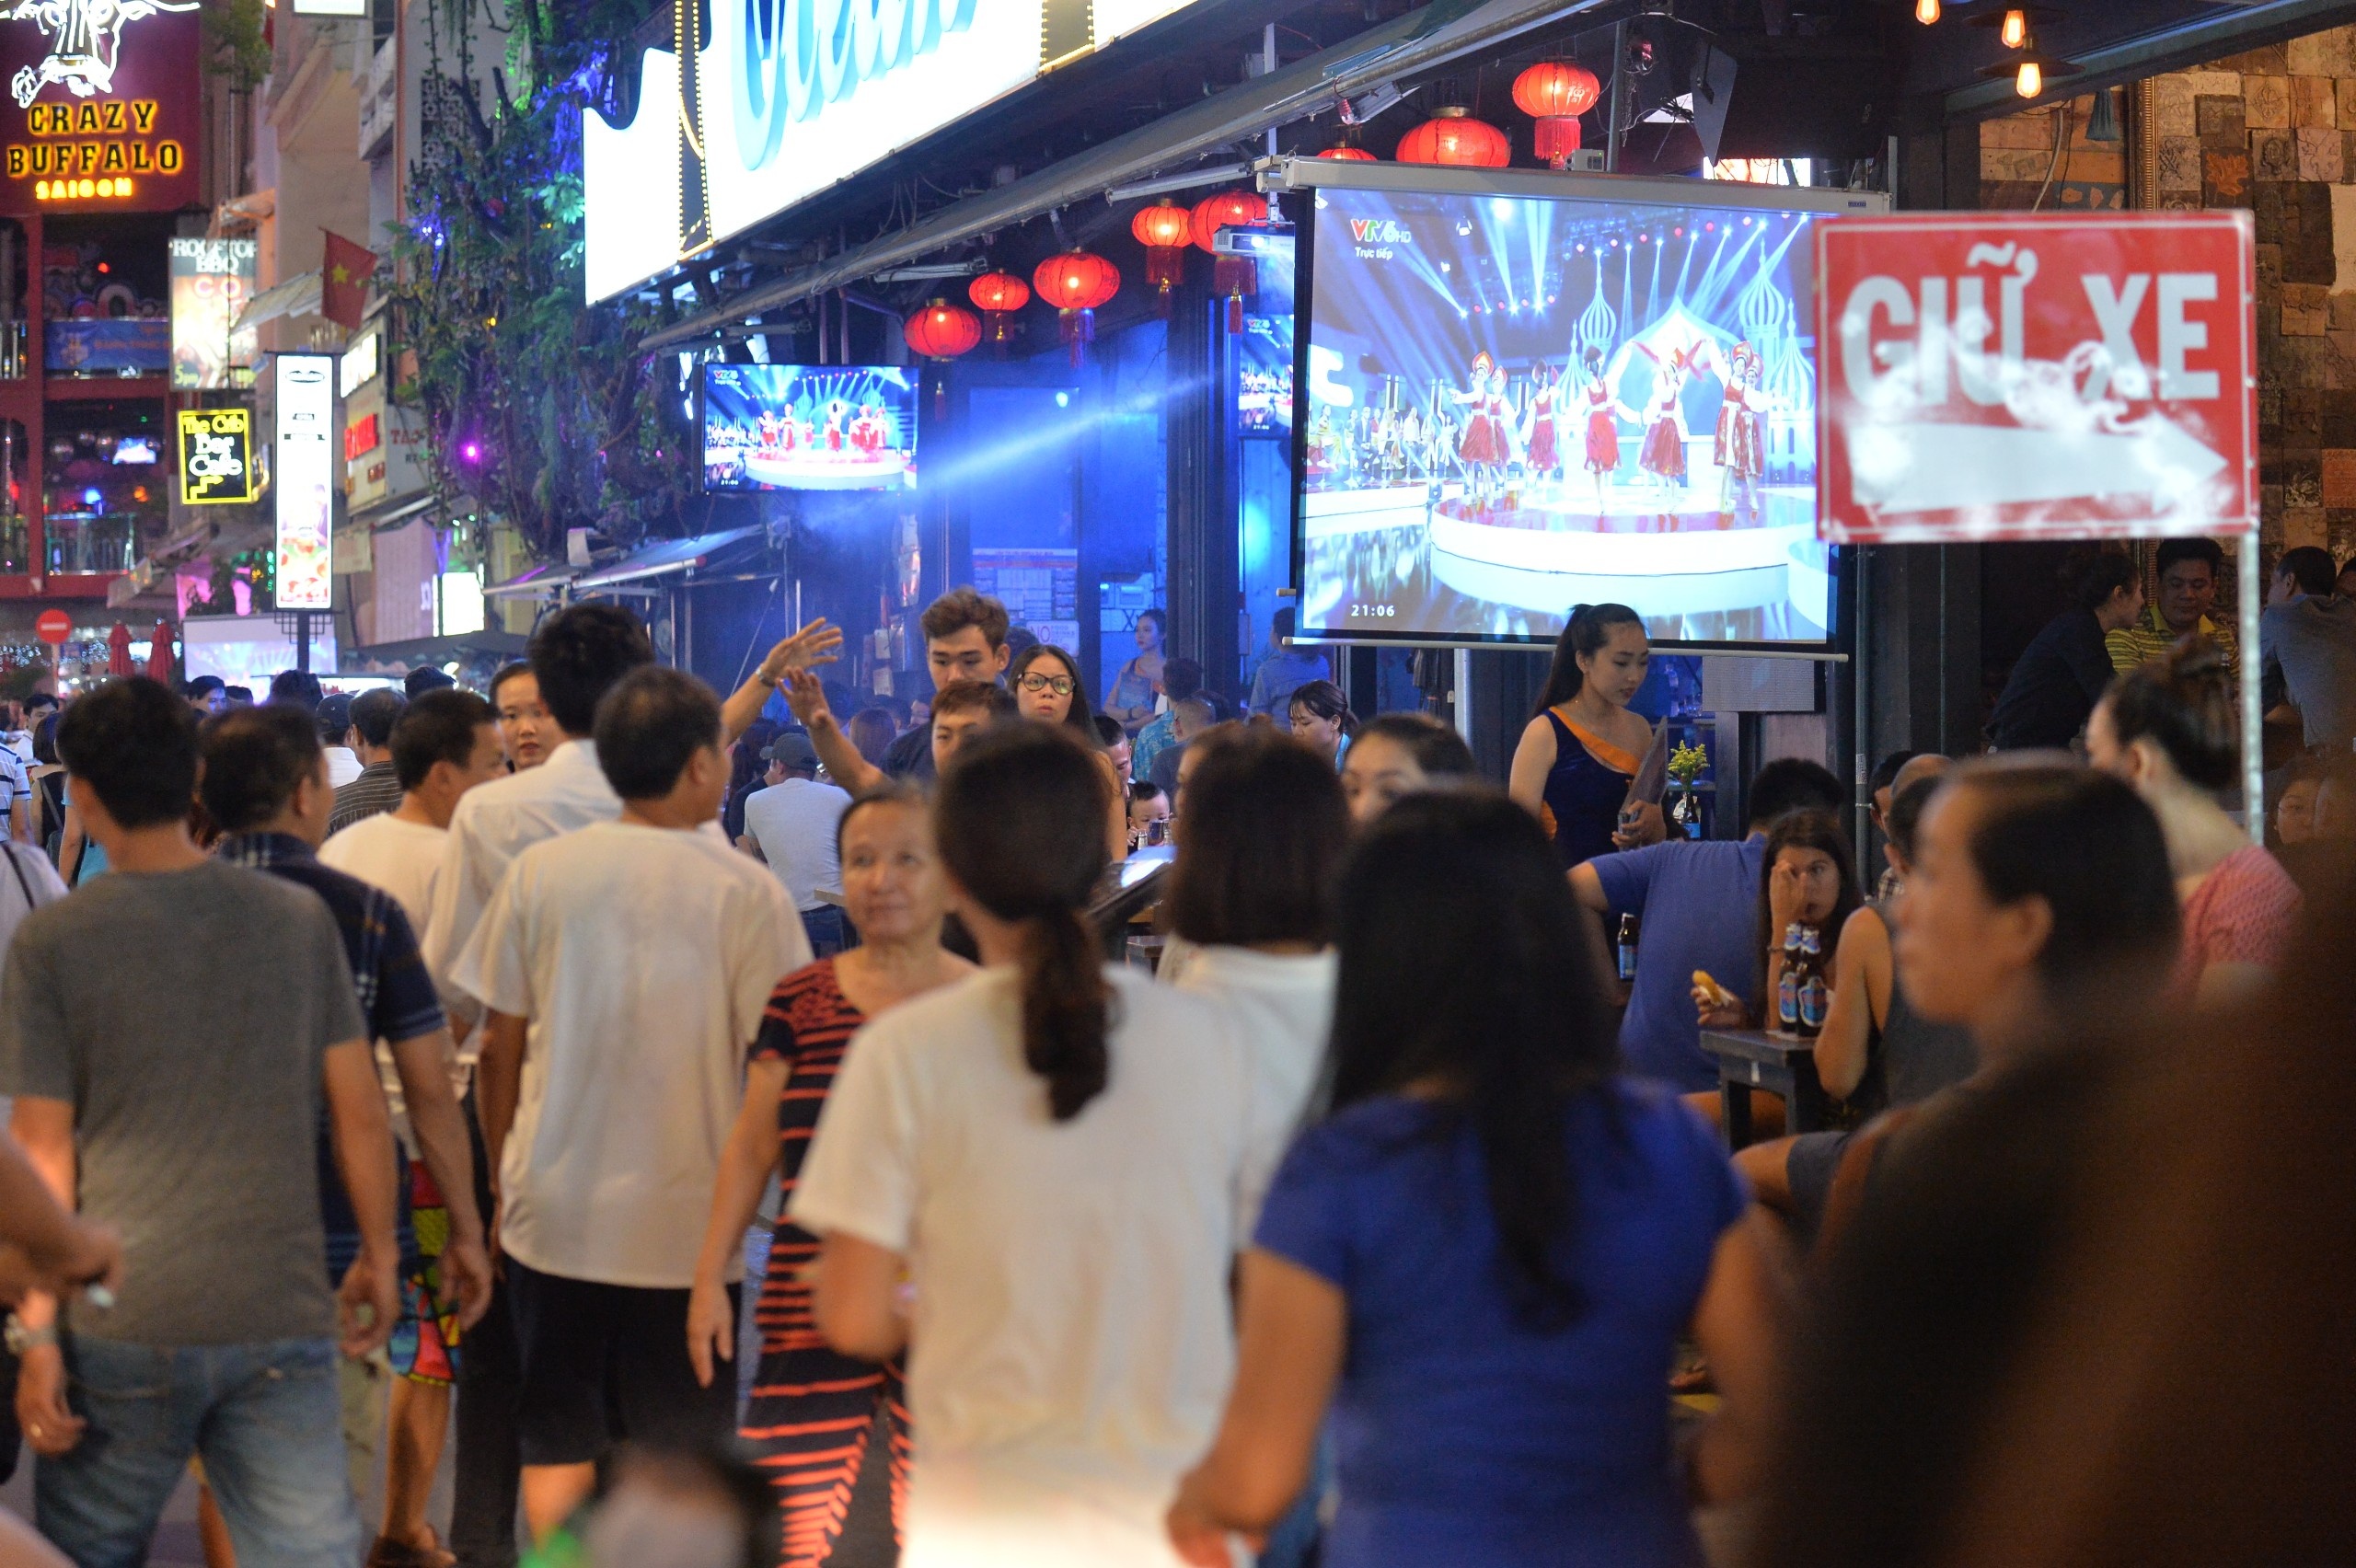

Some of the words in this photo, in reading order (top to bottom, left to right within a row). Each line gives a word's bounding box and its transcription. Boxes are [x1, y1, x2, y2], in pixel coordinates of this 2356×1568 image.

[29, 100, 156, 134] CRAZY
[8, 141, 181, 176] BUFFALO
[35, 178, 133, 200] SAIGON
[196, 255, 239, 275] BBQ
[2081, 272, 2221, 401] XE
[1351, 604, 1395, 617] 21:06
